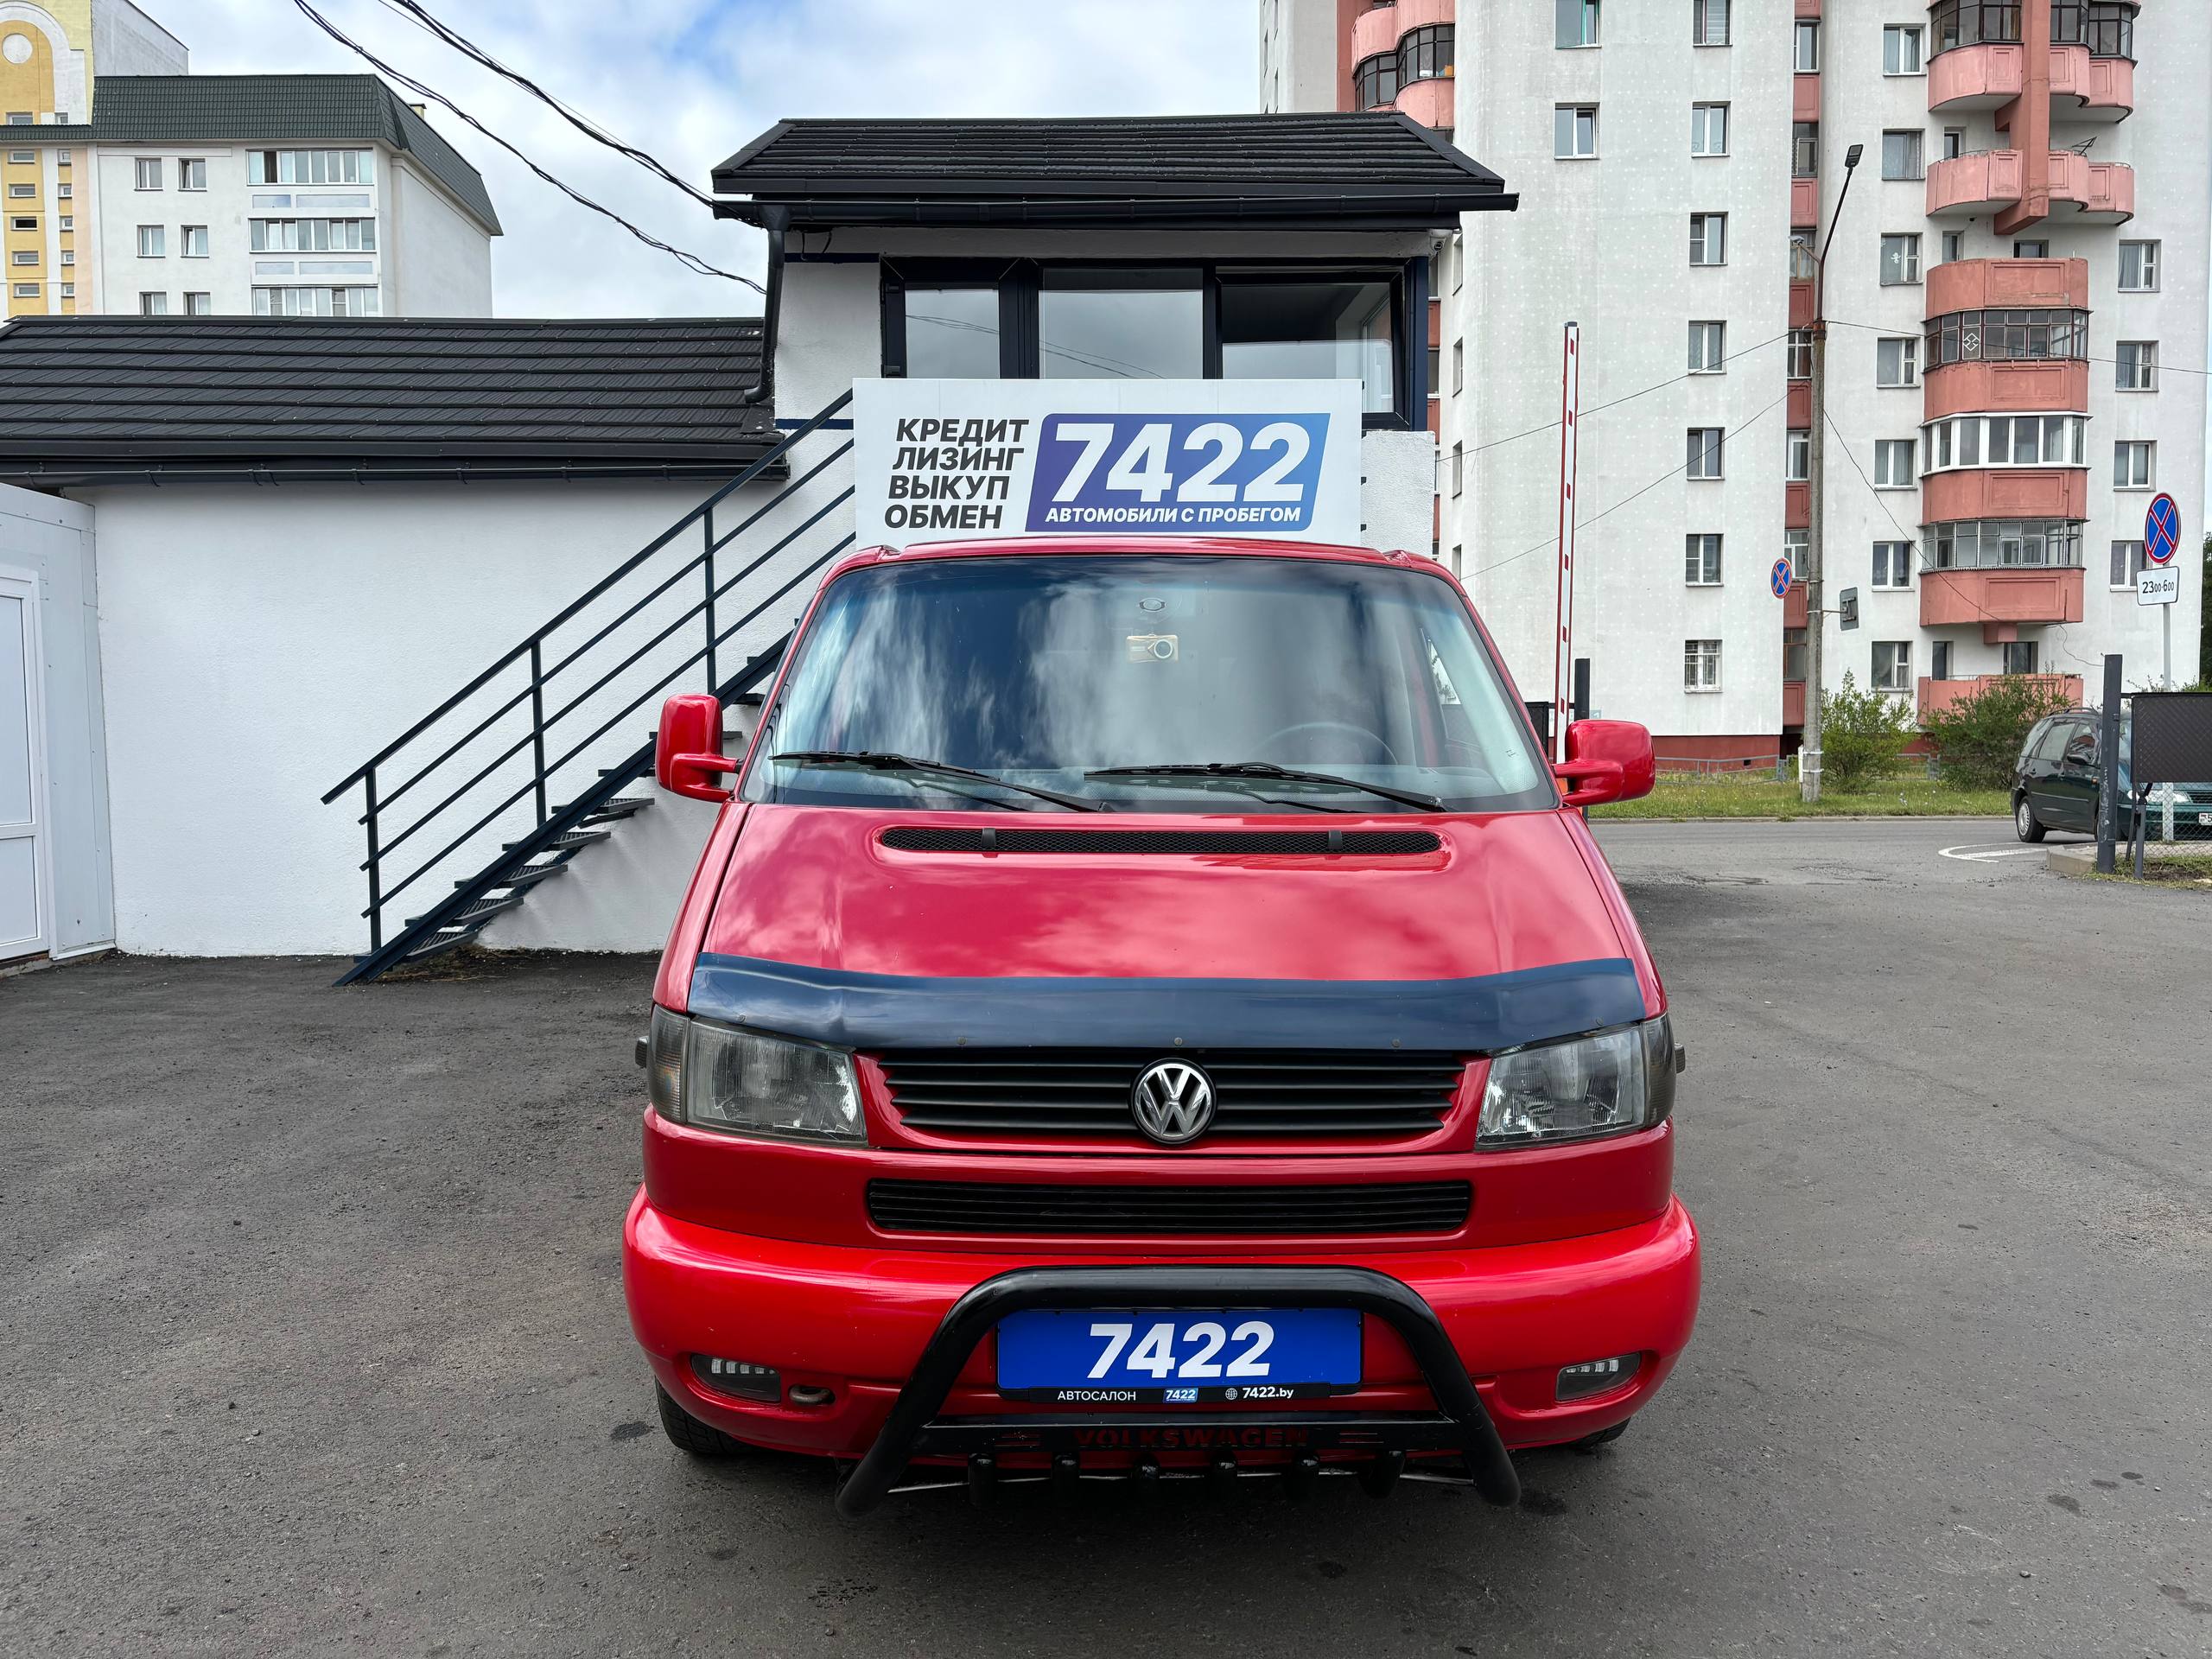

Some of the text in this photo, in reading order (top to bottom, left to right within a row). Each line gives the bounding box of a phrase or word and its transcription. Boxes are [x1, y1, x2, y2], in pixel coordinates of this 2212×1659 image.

[896, 418, 1029, 447] КРЕДИТ
[892, 447, 1025, 471] ЛИЗИНГ
[1051, 422, 1311, 503] 7422
[888, 474, 1010, 500] ВЫКУП
[884, 504, 1003, 529] ОБМЕН
[1045, 507, 1301, 523] АВТОМОБИЛИ С ПРОБЕГОМ
[1087, 1321, 1274, 1379] 7422
[1057, 1390, 1137, 1402] АВТОСАЛОН
[1166, 1389, 1196, 1400] 7422
[1243, 1386, 1294, 1399] 7422.by
[1074, 1427, 1310, 1446] VOLKSWAGEN
